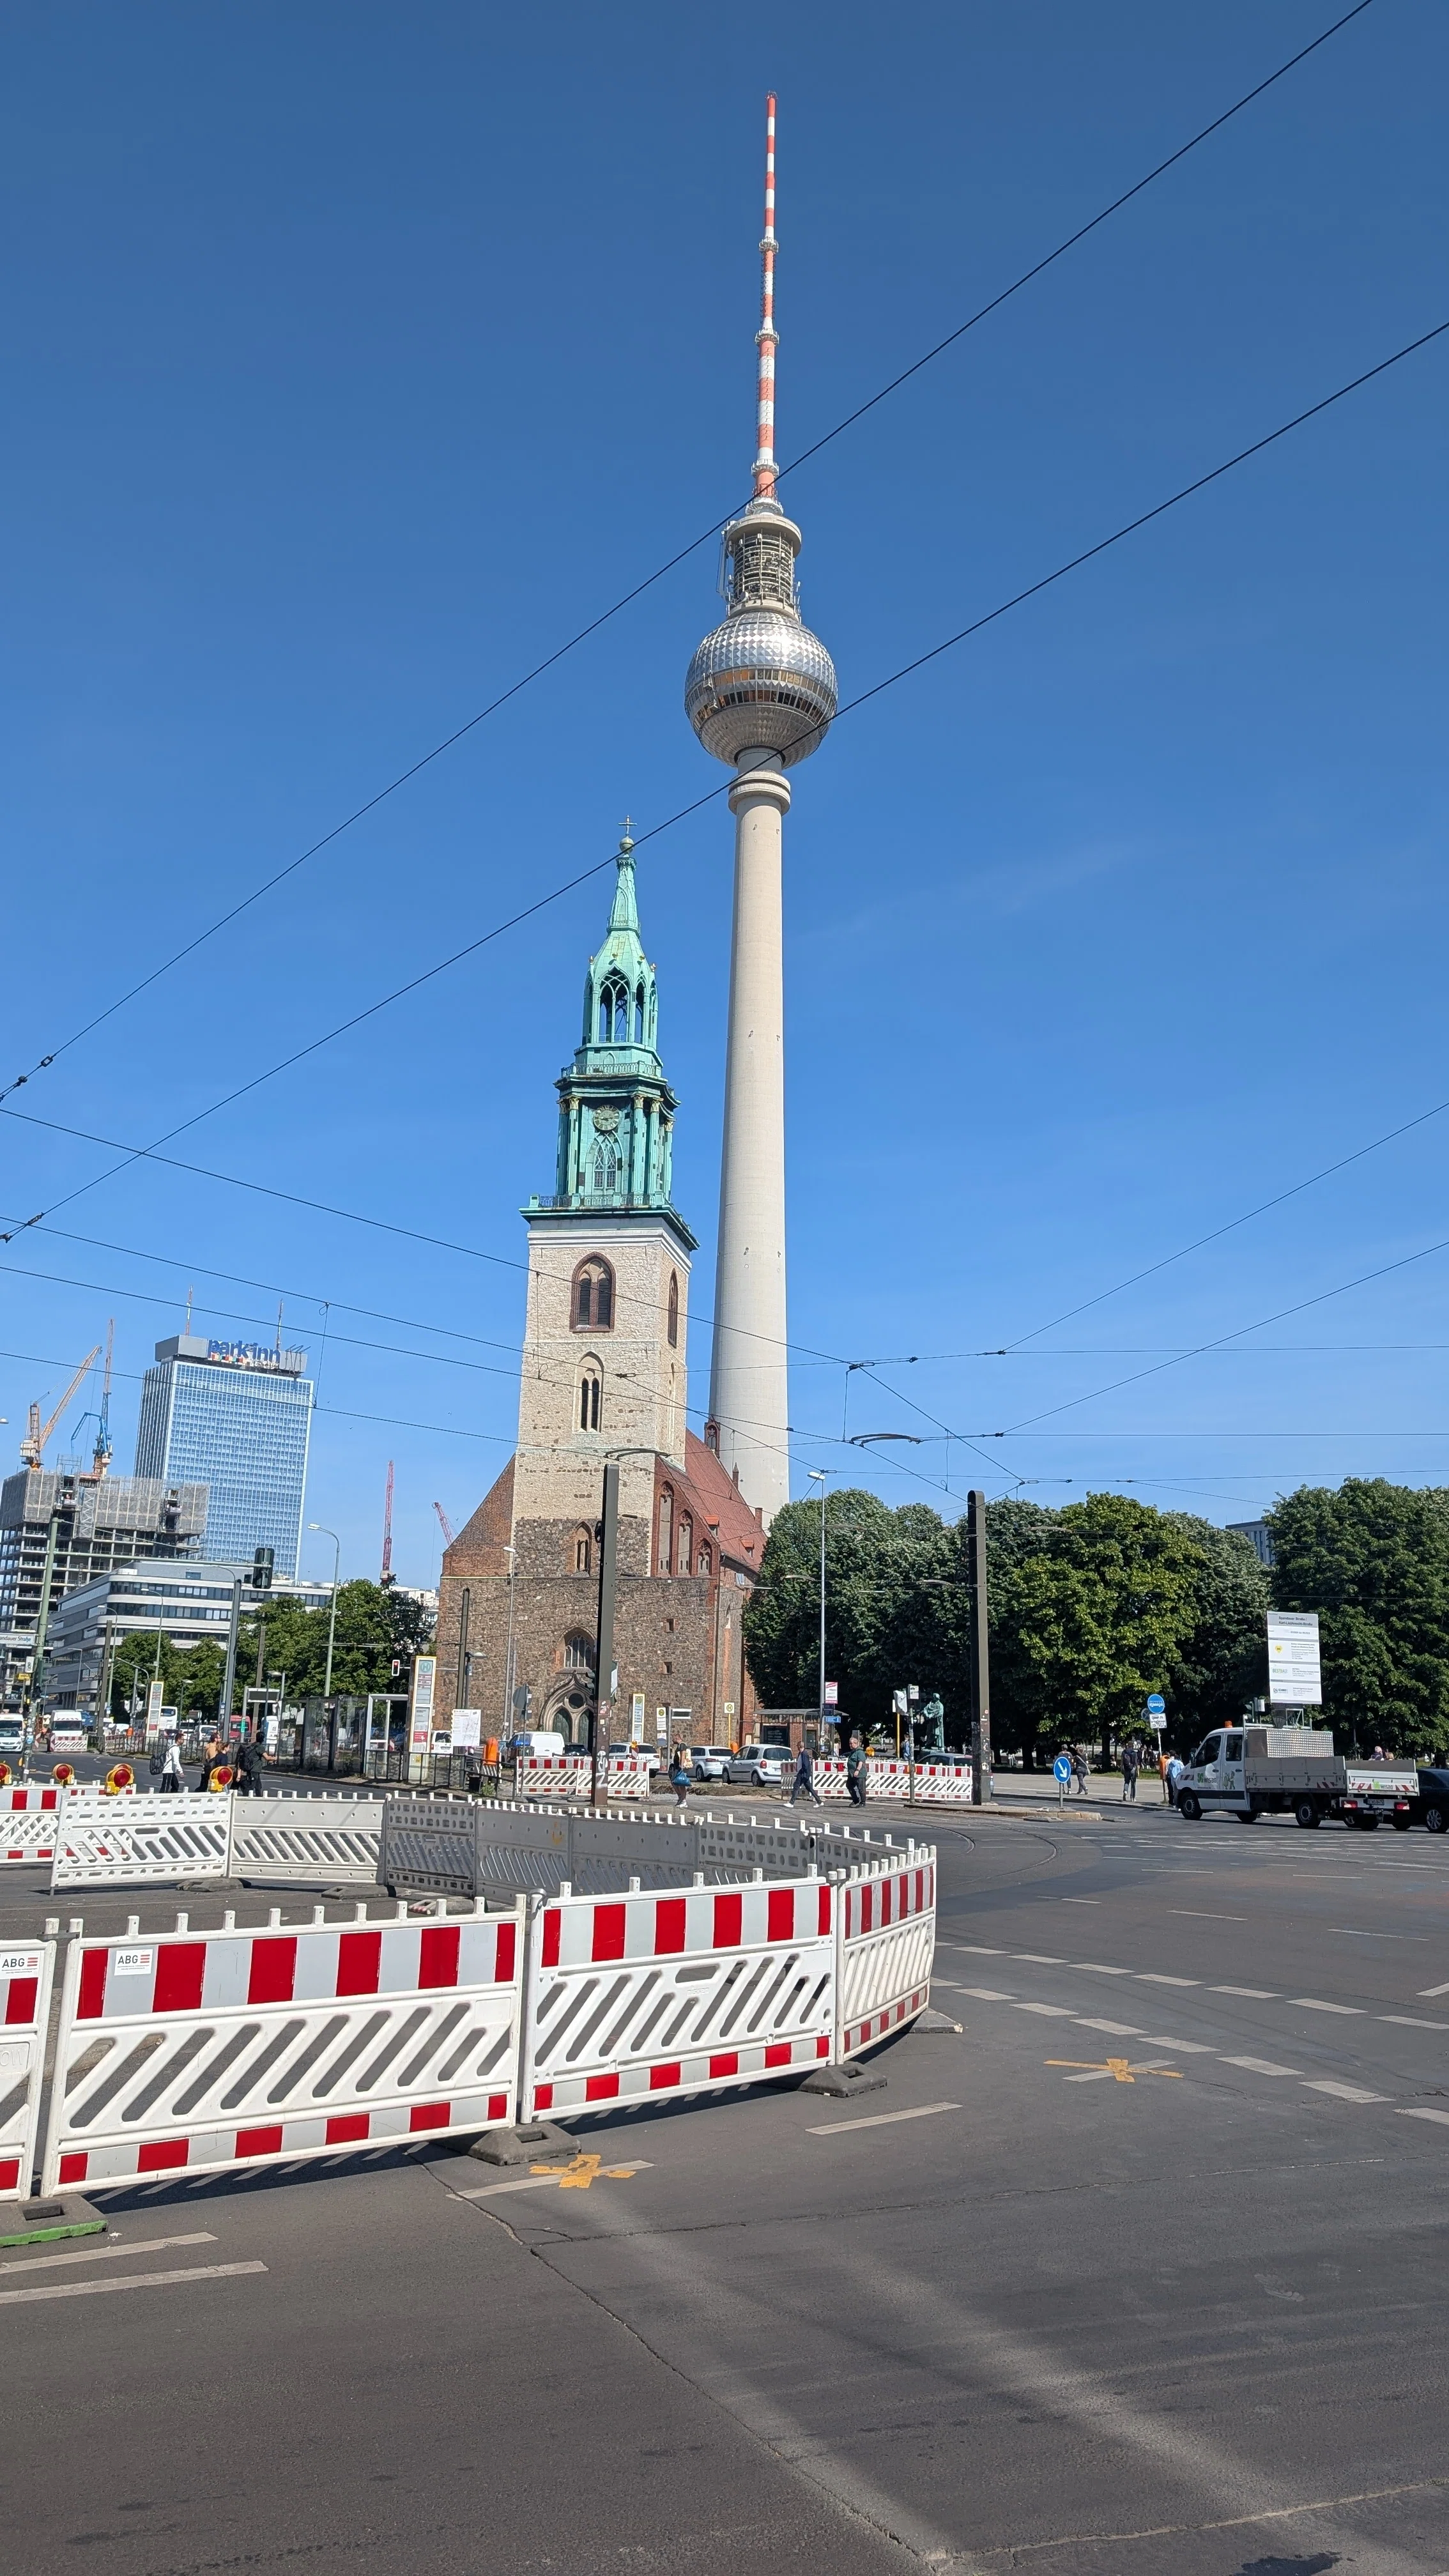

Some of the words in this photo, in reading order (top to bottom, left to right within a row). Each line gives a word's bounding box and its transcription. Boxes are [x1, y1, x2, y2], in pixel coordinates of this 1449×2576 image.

[208, 1339, 249, 1359] park
[2, 1958, 25, 1968] ABG
[118, 1955, 138, 1965] ABG
